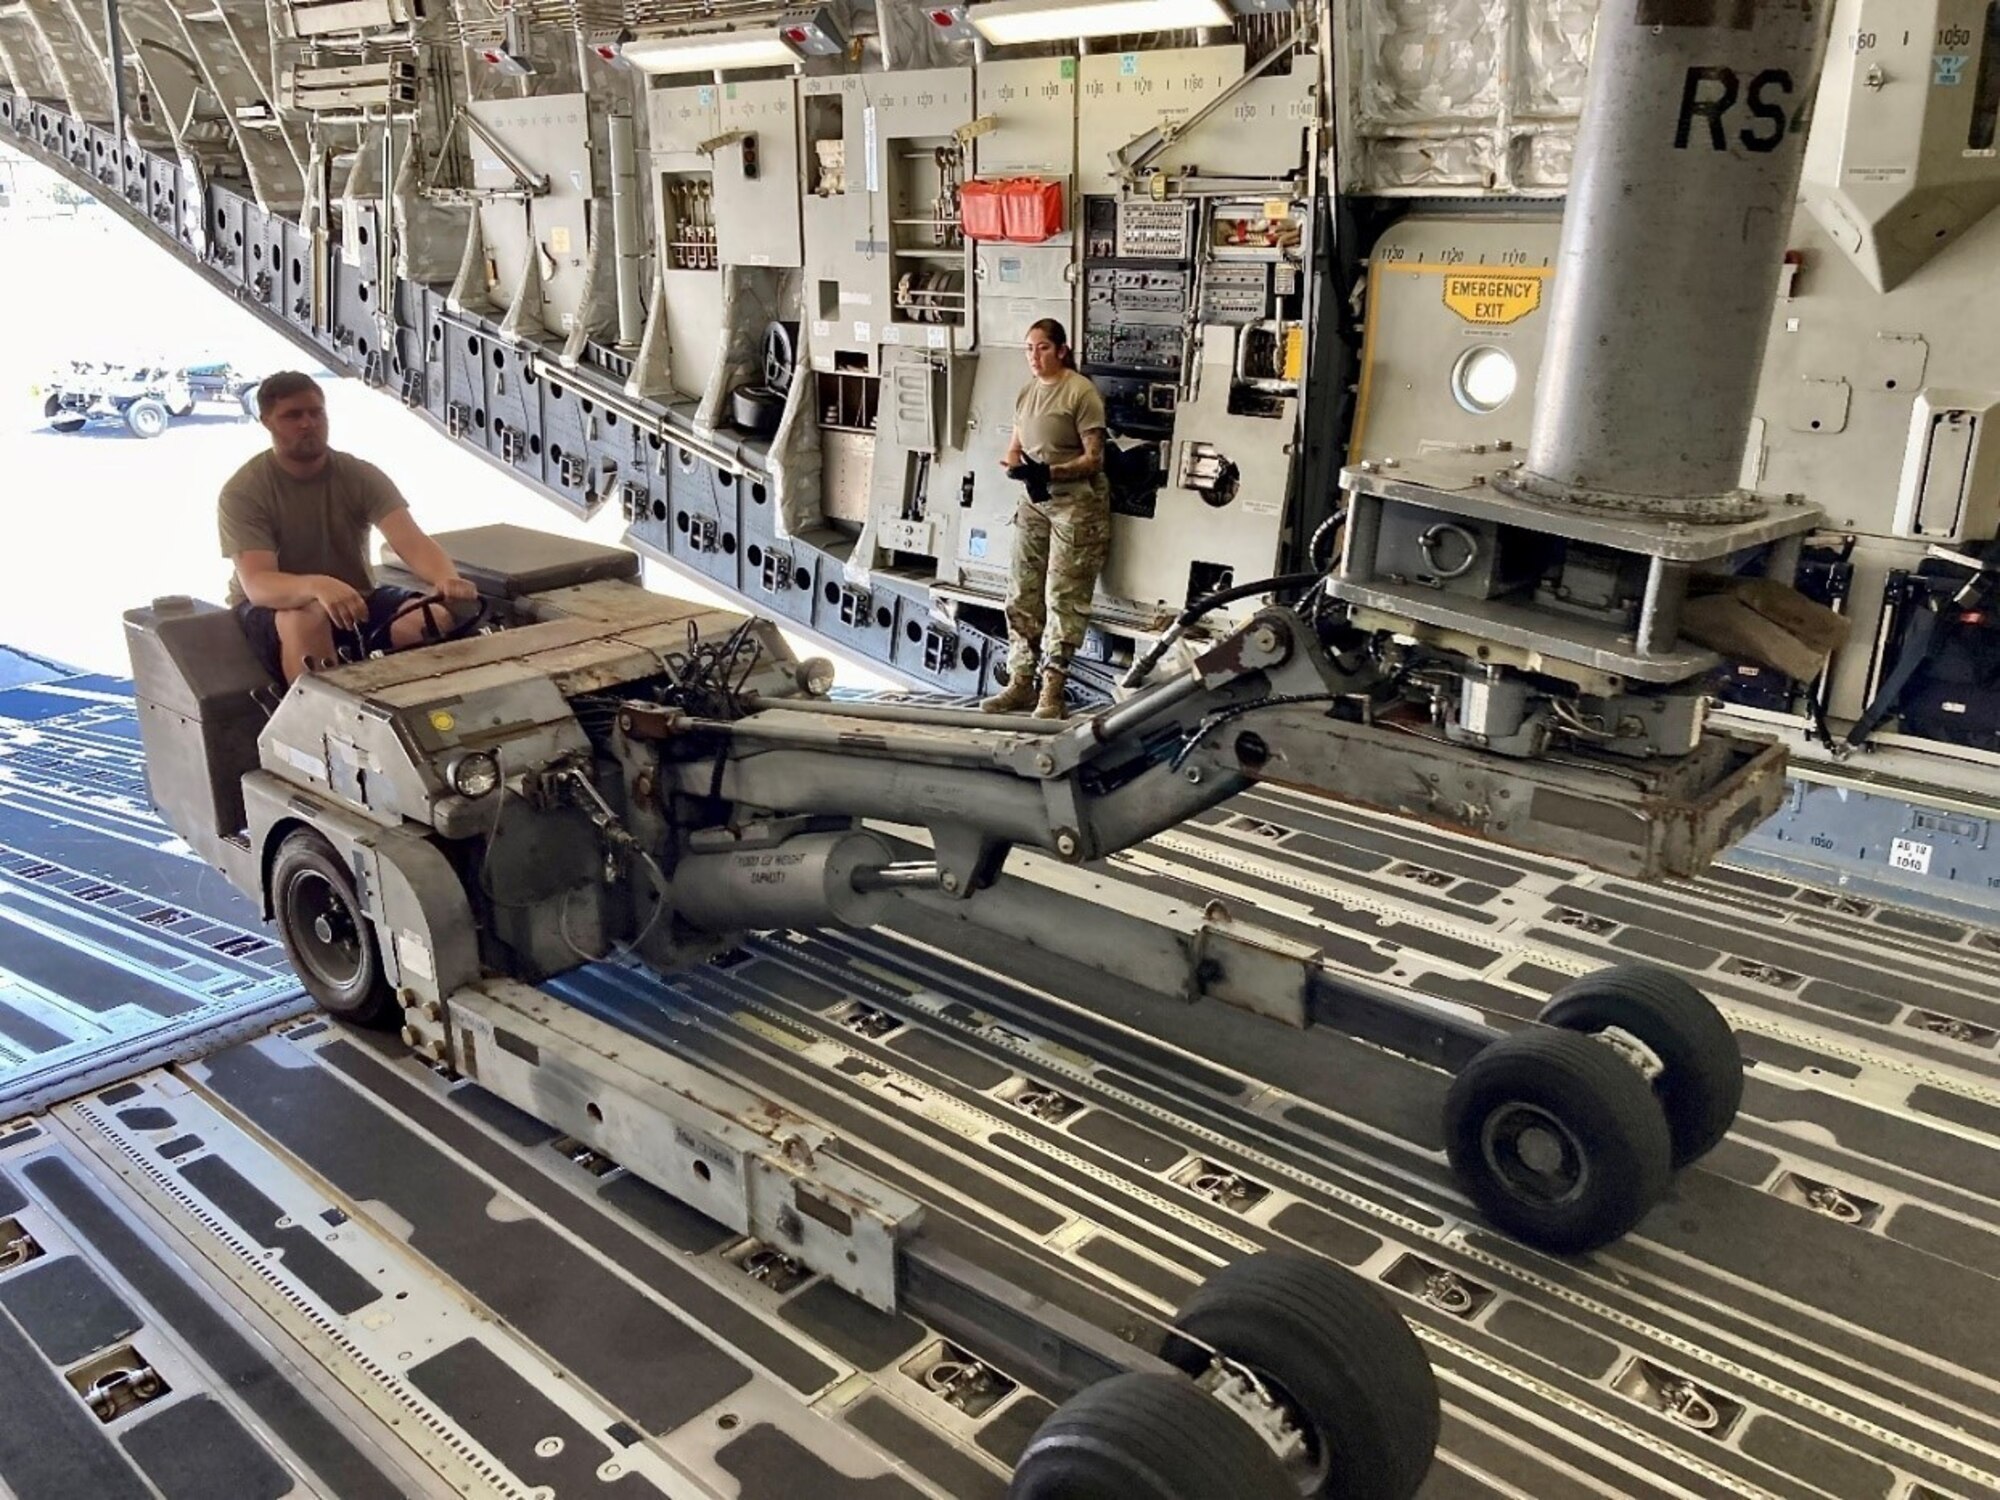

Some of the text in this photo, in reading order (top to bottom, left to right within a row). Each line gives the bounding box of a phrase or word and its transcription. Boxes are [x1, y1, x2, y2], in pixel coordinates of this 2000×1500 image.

[1938, 29, 1970, 46] 1050
[1235, 105, 1256, 118] 1150
[1382, 248, 1526, 264] 1130 1120 1110
[1452, 281, 1532, 298] EMERGENCY
[1475, 303, 1504, 318] EXIT
[1810, 835, 1834, 850] 1050
